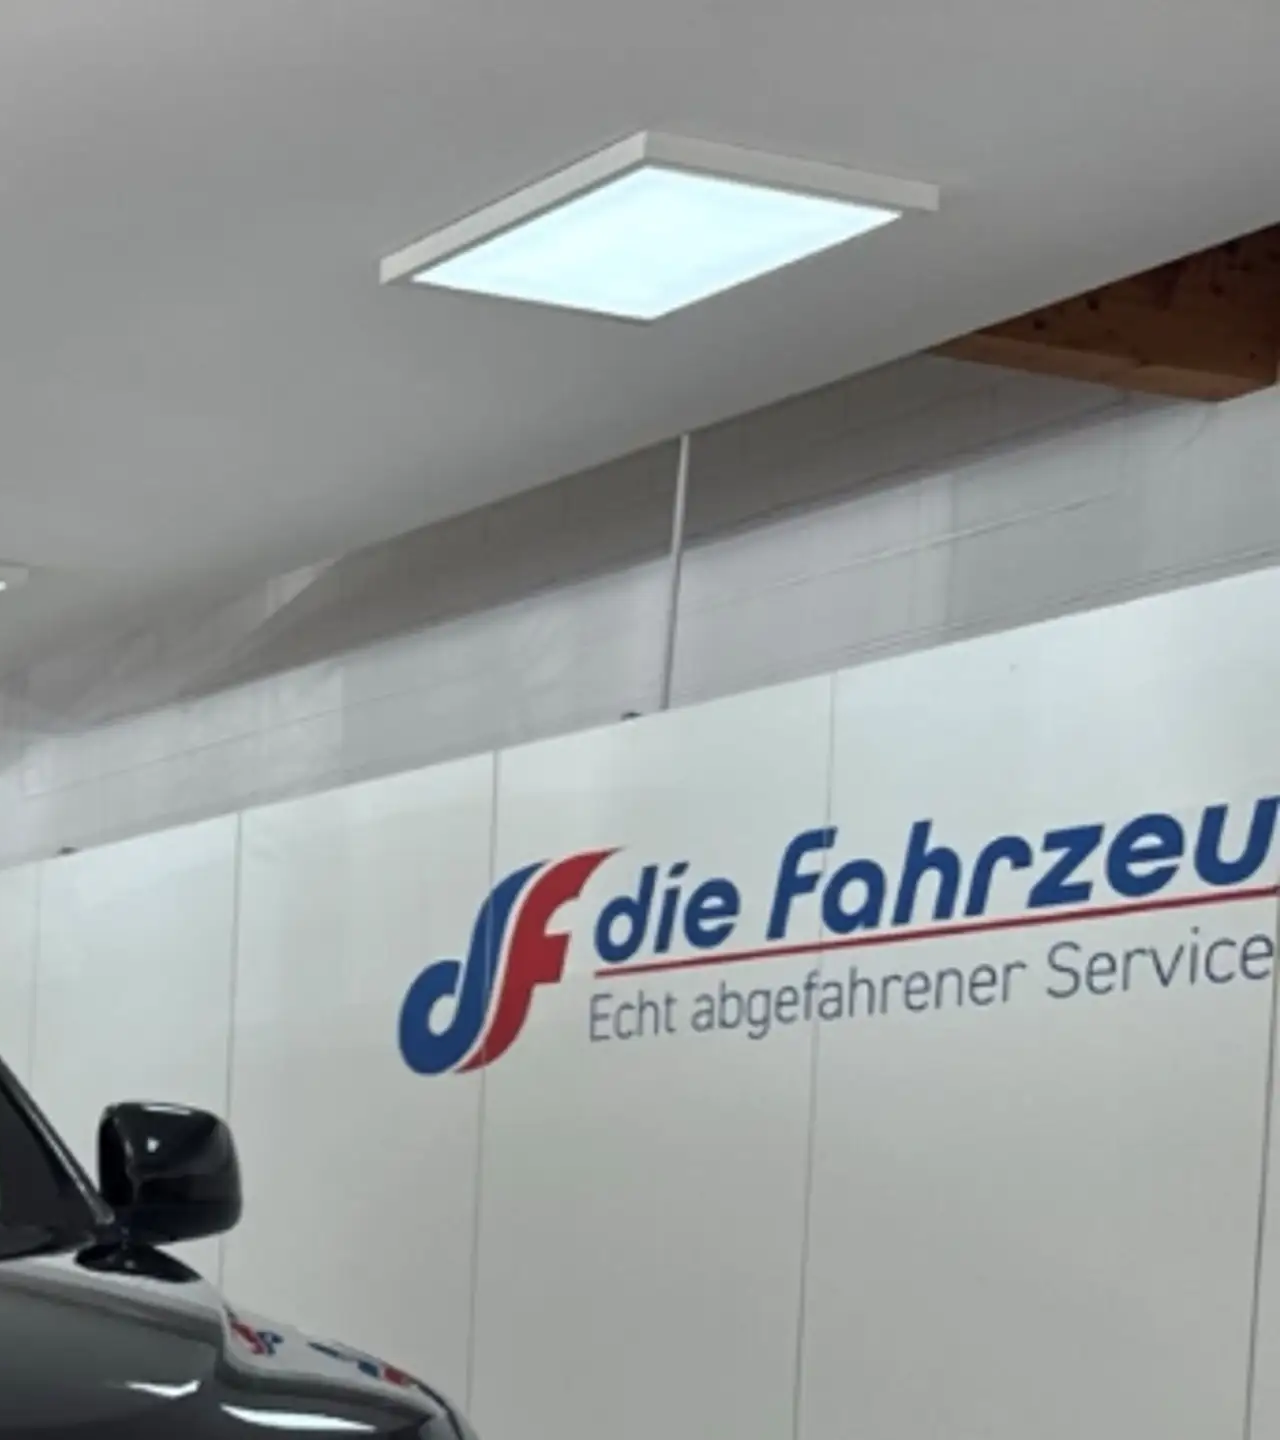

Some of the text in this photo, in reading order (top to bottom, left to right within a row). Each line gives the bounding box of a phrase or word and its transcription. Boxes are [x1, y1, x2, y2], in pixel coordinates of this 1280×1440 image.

[594, 794, 1280, 963] die Fahrzeu
[589, 925, 1275, 1042] Echt abgefahrener Service
